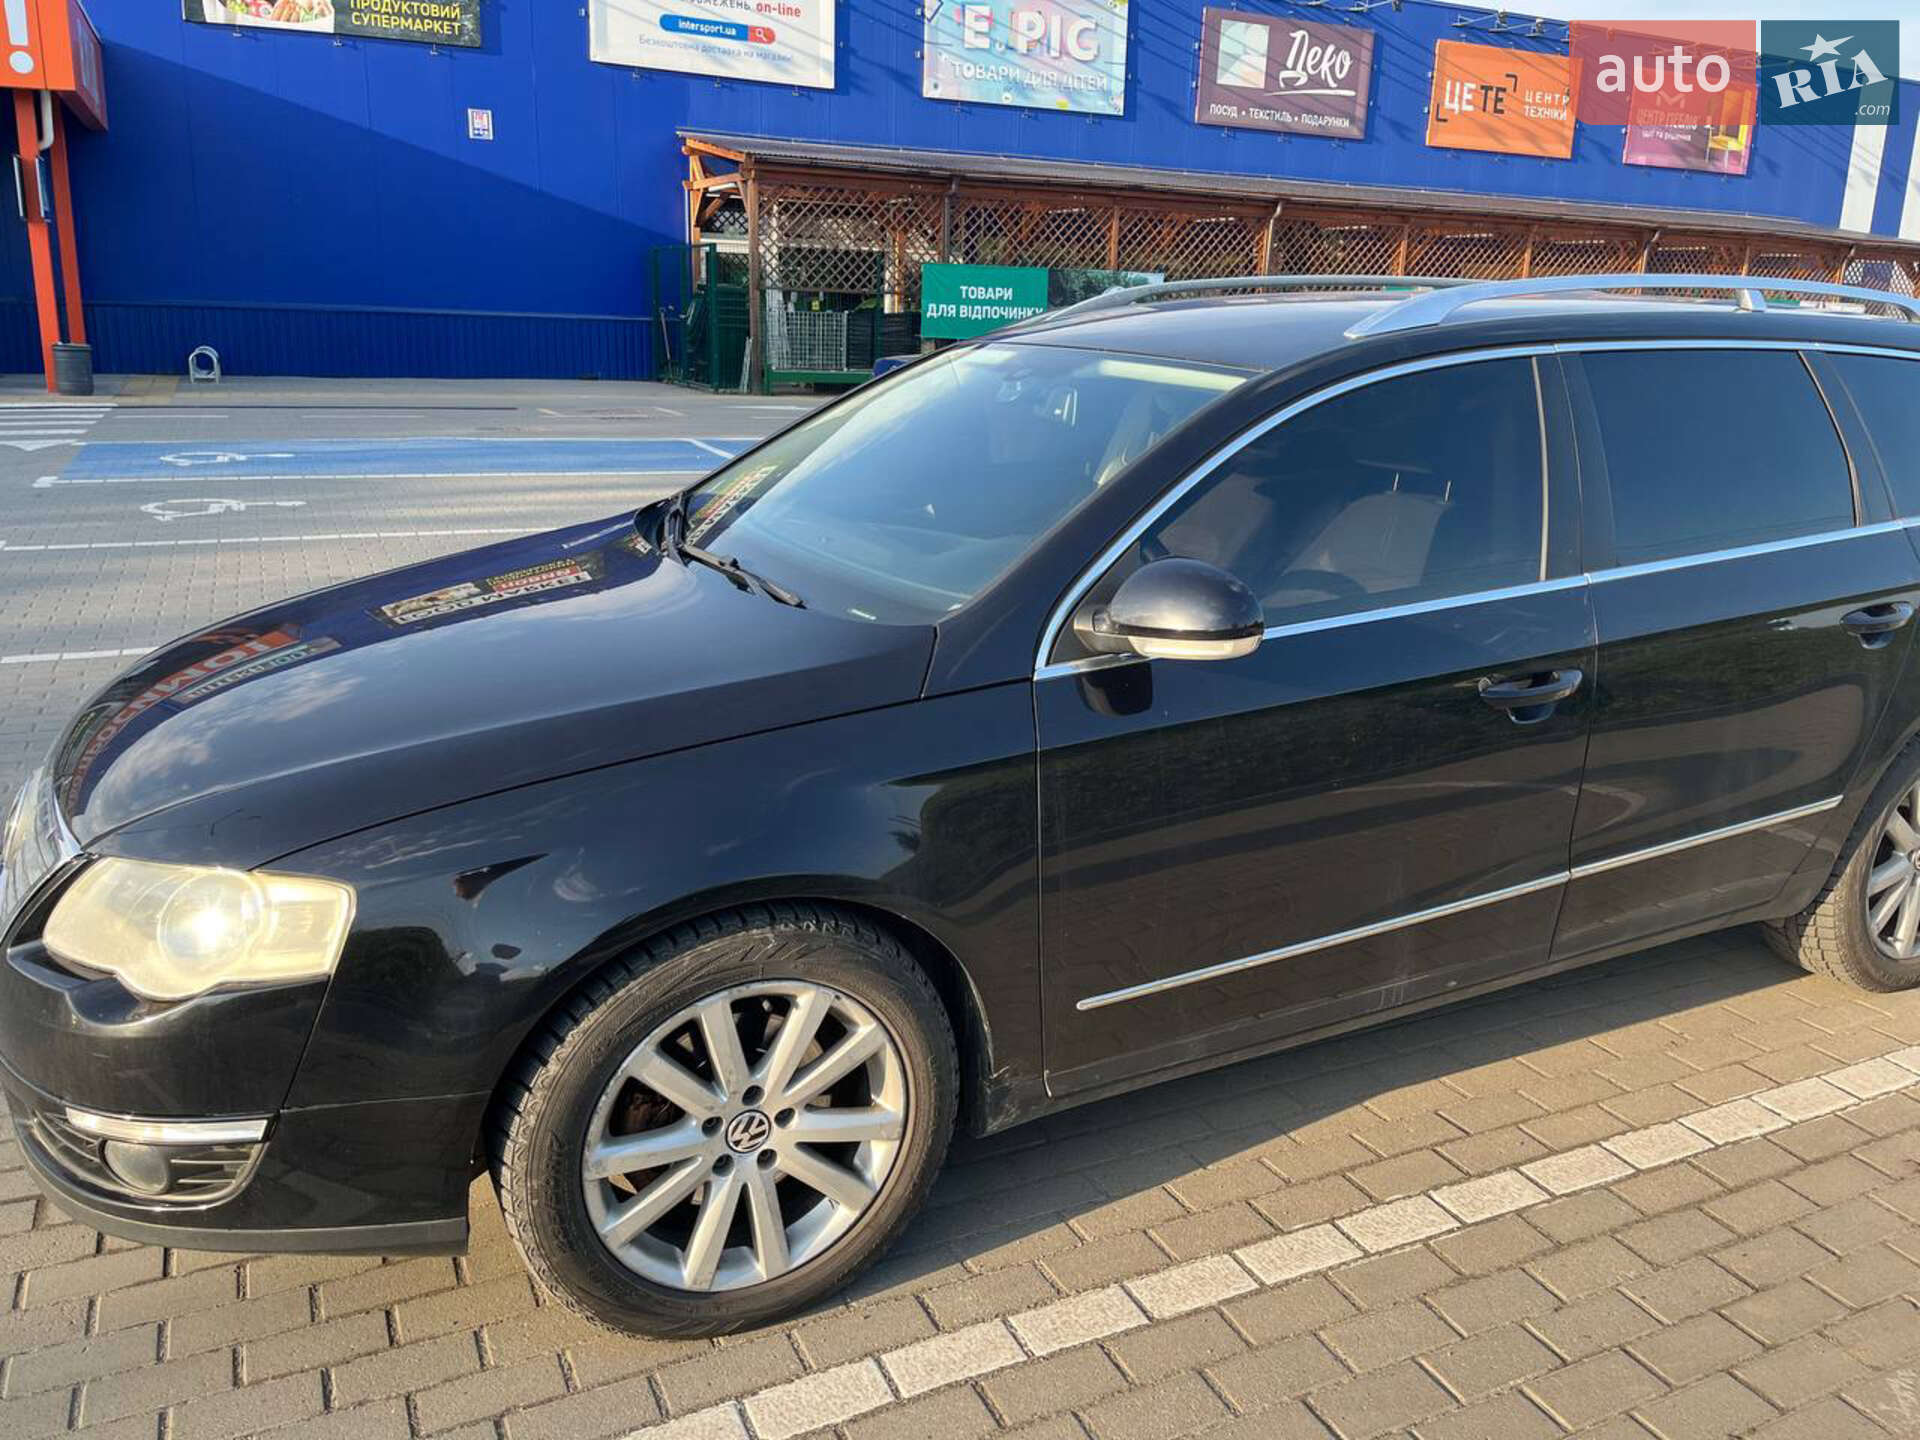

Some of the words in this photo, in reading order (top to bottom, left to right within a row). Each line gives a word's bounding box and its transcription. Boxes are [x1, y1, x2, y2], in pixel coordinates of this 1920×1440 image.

[350, 0, 461, 20] ПРОДУКТОВИЙ
[756, 3, 802, 18] on-line
[351, 12, 462, 36] СУПЕРМАРКЕТ
[678, 19, 737, 37] intersport.ua
[1279, 29, 1353, 88] Деко
[951, 63, 1020, 82] ТОВАРИ
[1023, 70, 1058, 88] ДЛЯ
[1062, 71, 1109, 91] ДІТЕЙ
[1525, 90, 1570, 106] ЦЕНТР
[1209, 104, 1238, 118] ПОСУД
[1249, 108, 1293, 123] ТЕКСТИЛЬ
[1301, 113, 1350, 128] ПОДАРУНКИ
[1524, 105, 1568, 121] ТЕХНІКИ
[960, 285, 1013, 300] ТОВАРИ
[926, 304, 956, 319] ДЛЯ
